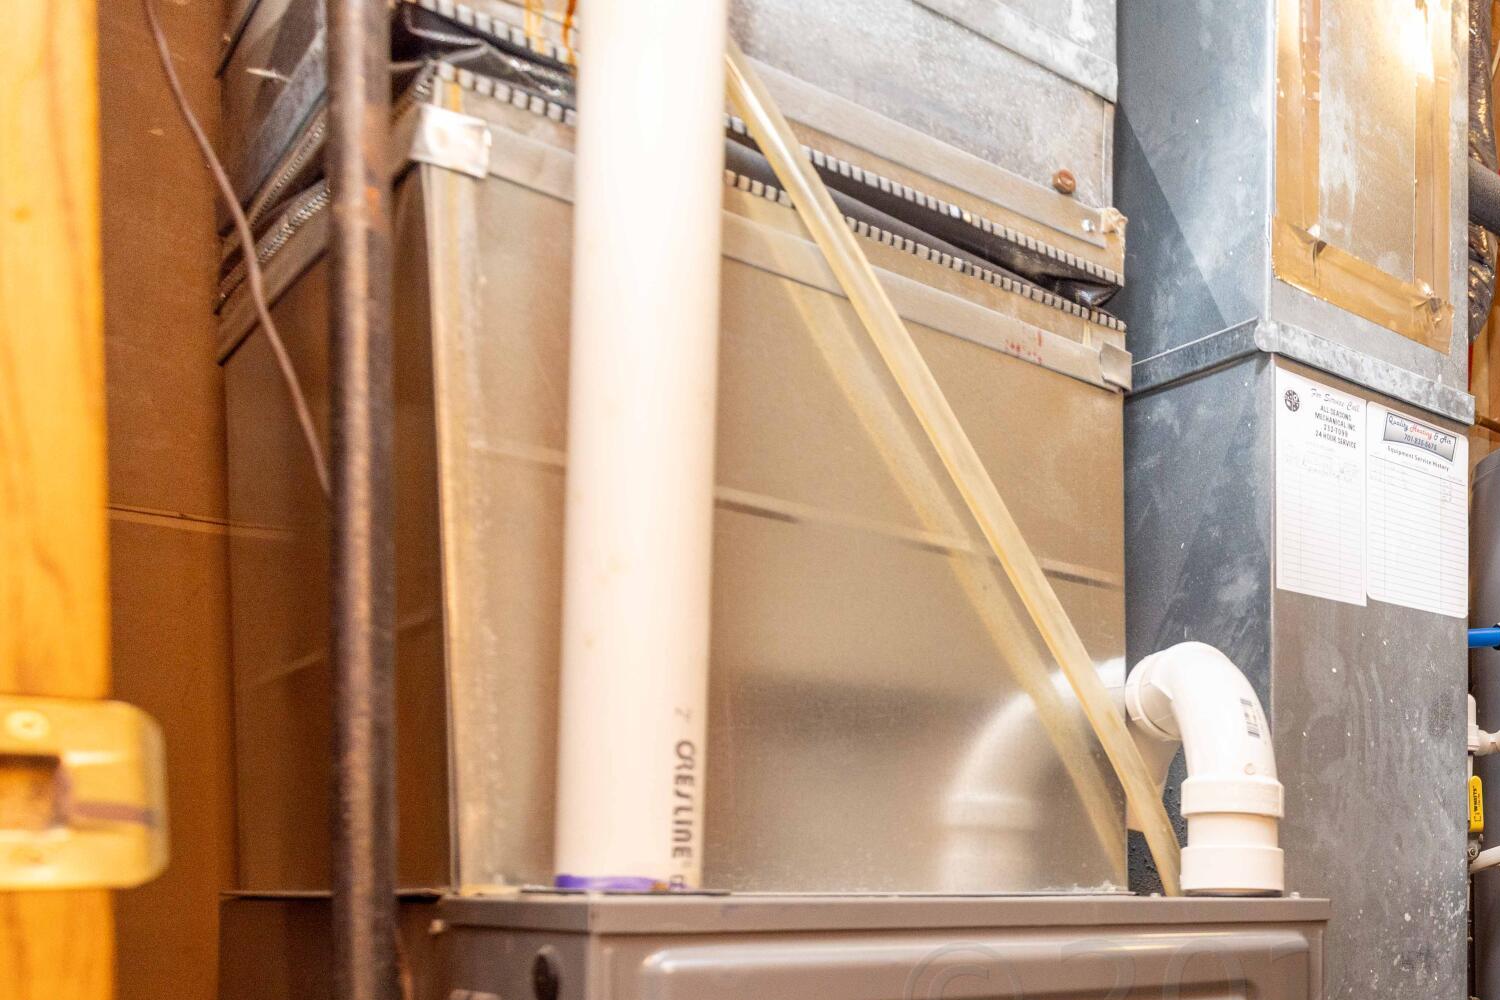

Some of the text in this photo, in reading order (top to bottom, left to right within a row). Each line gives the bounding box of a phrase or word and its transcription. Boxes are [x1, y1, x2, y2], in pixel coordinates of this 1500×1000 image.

[1314, 411, 1346, 428] MECHANICAL
[1388, 415, 1409, 432] Quality
[1387, 445, 1449, 472] Equipment Service History
